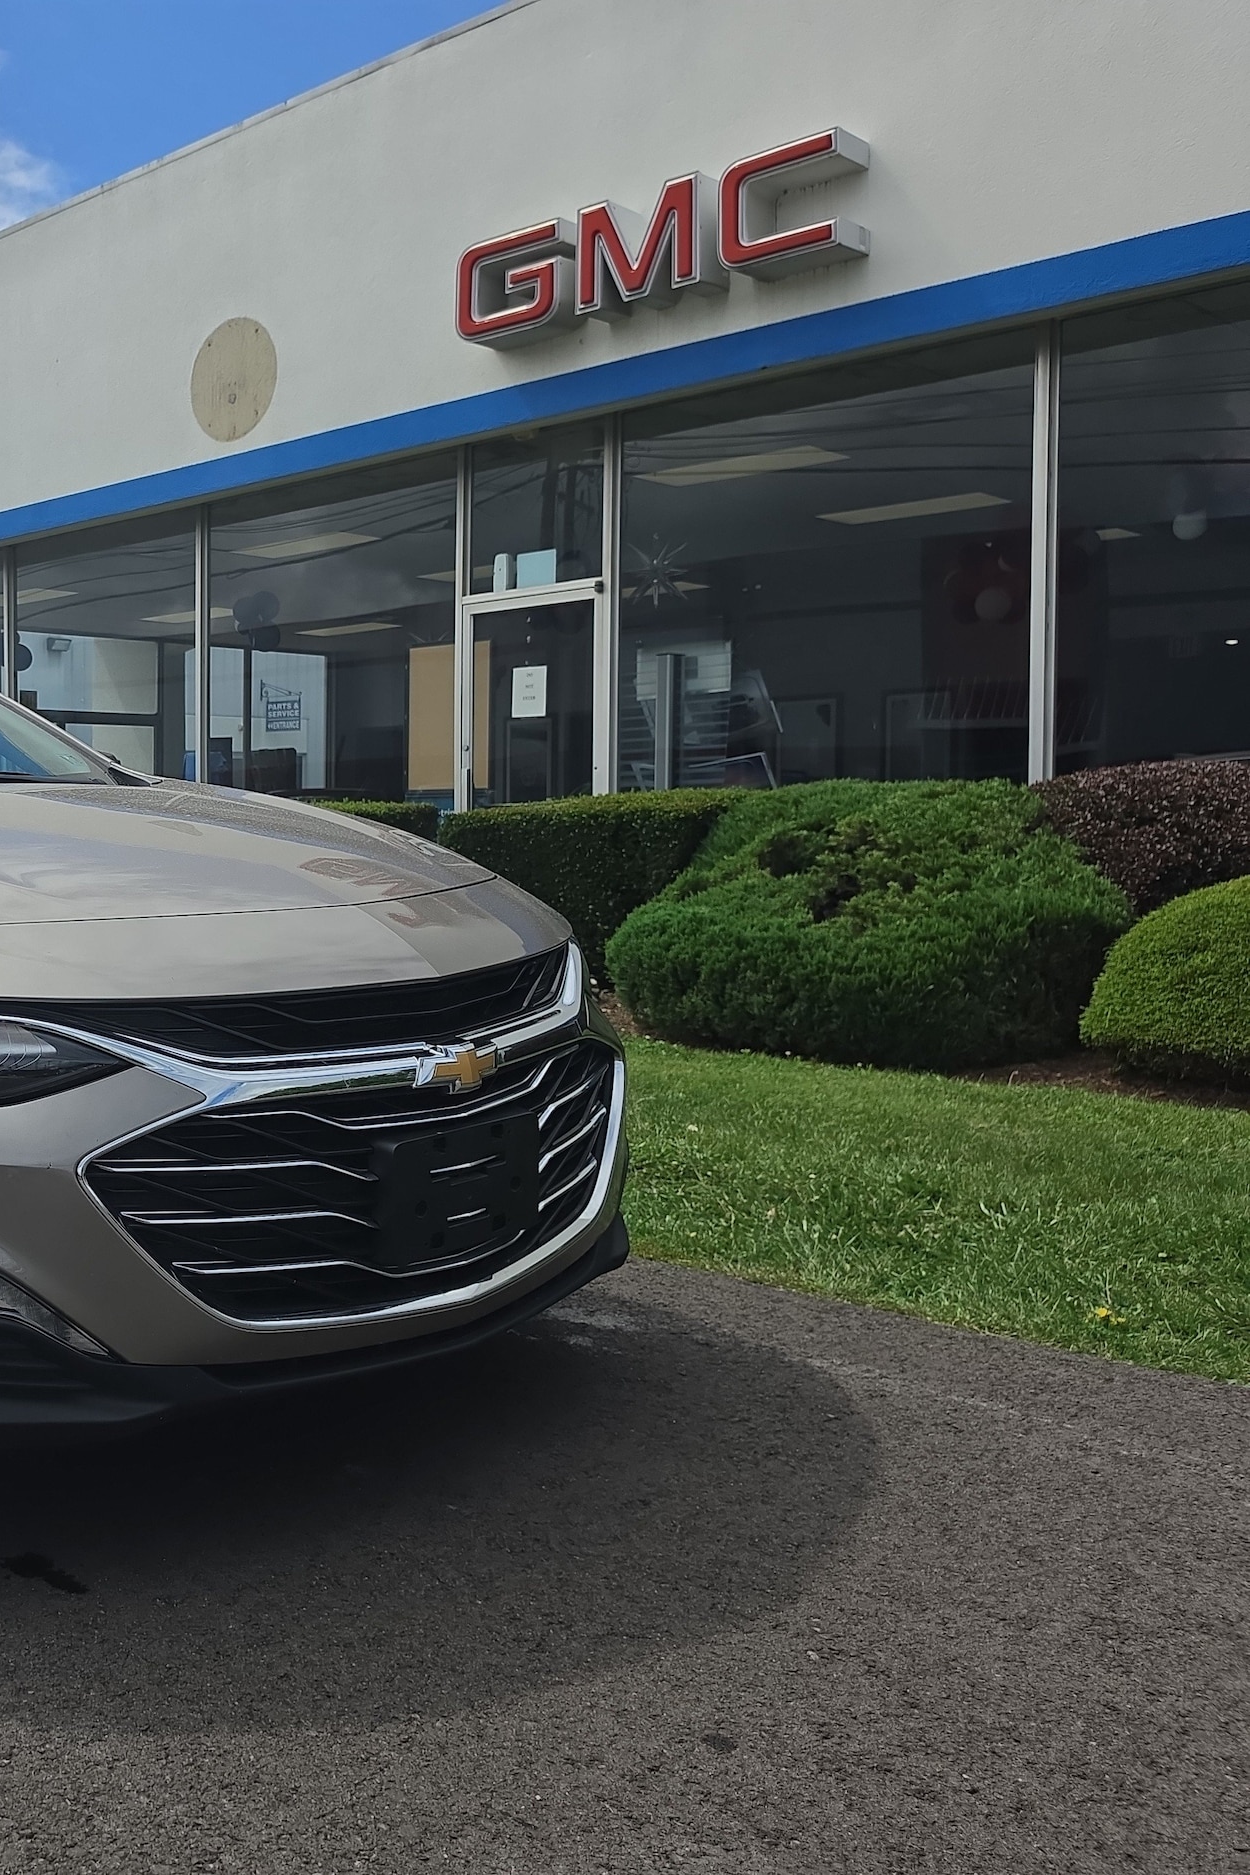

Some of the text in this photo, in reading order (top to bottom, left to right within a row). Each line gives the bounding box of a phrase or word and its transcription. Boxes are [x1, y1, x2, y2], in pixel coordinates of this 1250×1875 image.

[456, 126, 844, 343] GMC
[267, 702, 292, 711] PARTS
[267, 710, 300, 718] SERVICE
[273, 720, 300, 730] ENTRANCE
